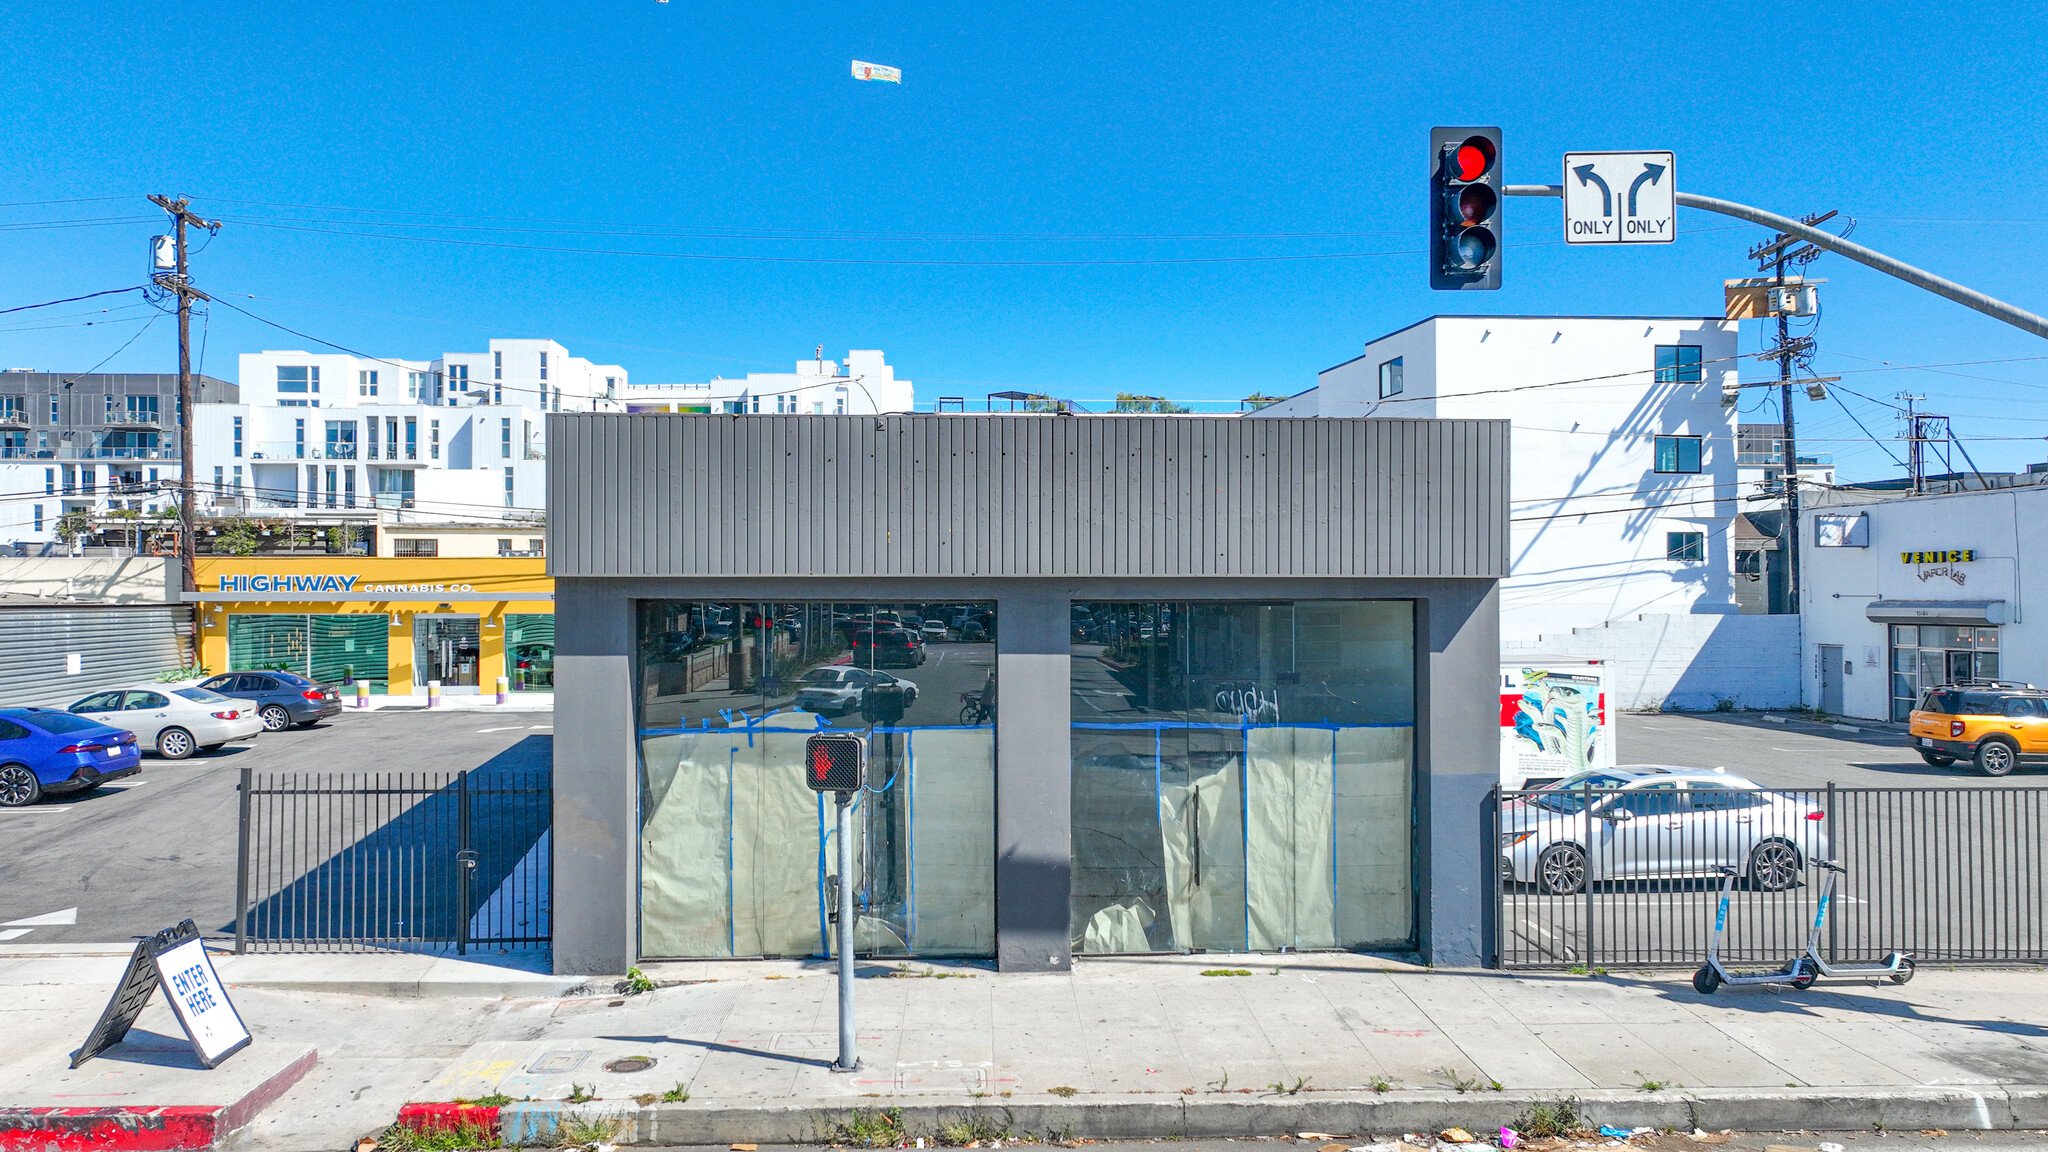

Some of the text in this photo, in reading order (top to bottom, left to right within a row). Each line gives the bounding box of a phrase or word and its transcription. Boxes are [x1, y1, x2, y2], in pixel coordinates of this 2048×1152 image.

[1573, 221, 1613, 235] ONLY
[1626, 220, 1666, 234] ONLY
[1901, 550, 1974, 564] VENICE
[219, 575, 478, 593] HIGHWAY CANNABIS CO.
[1950, 568, 1967, 586] LAB
[1500, 675, 1516, 687] L
[1717, 904, 1728, 924] BIRD
[1817, 901, 1828, 921] BIRD
[172, 963, 209, 996] ENTER
[185, 987, 217, 1017] HERE
